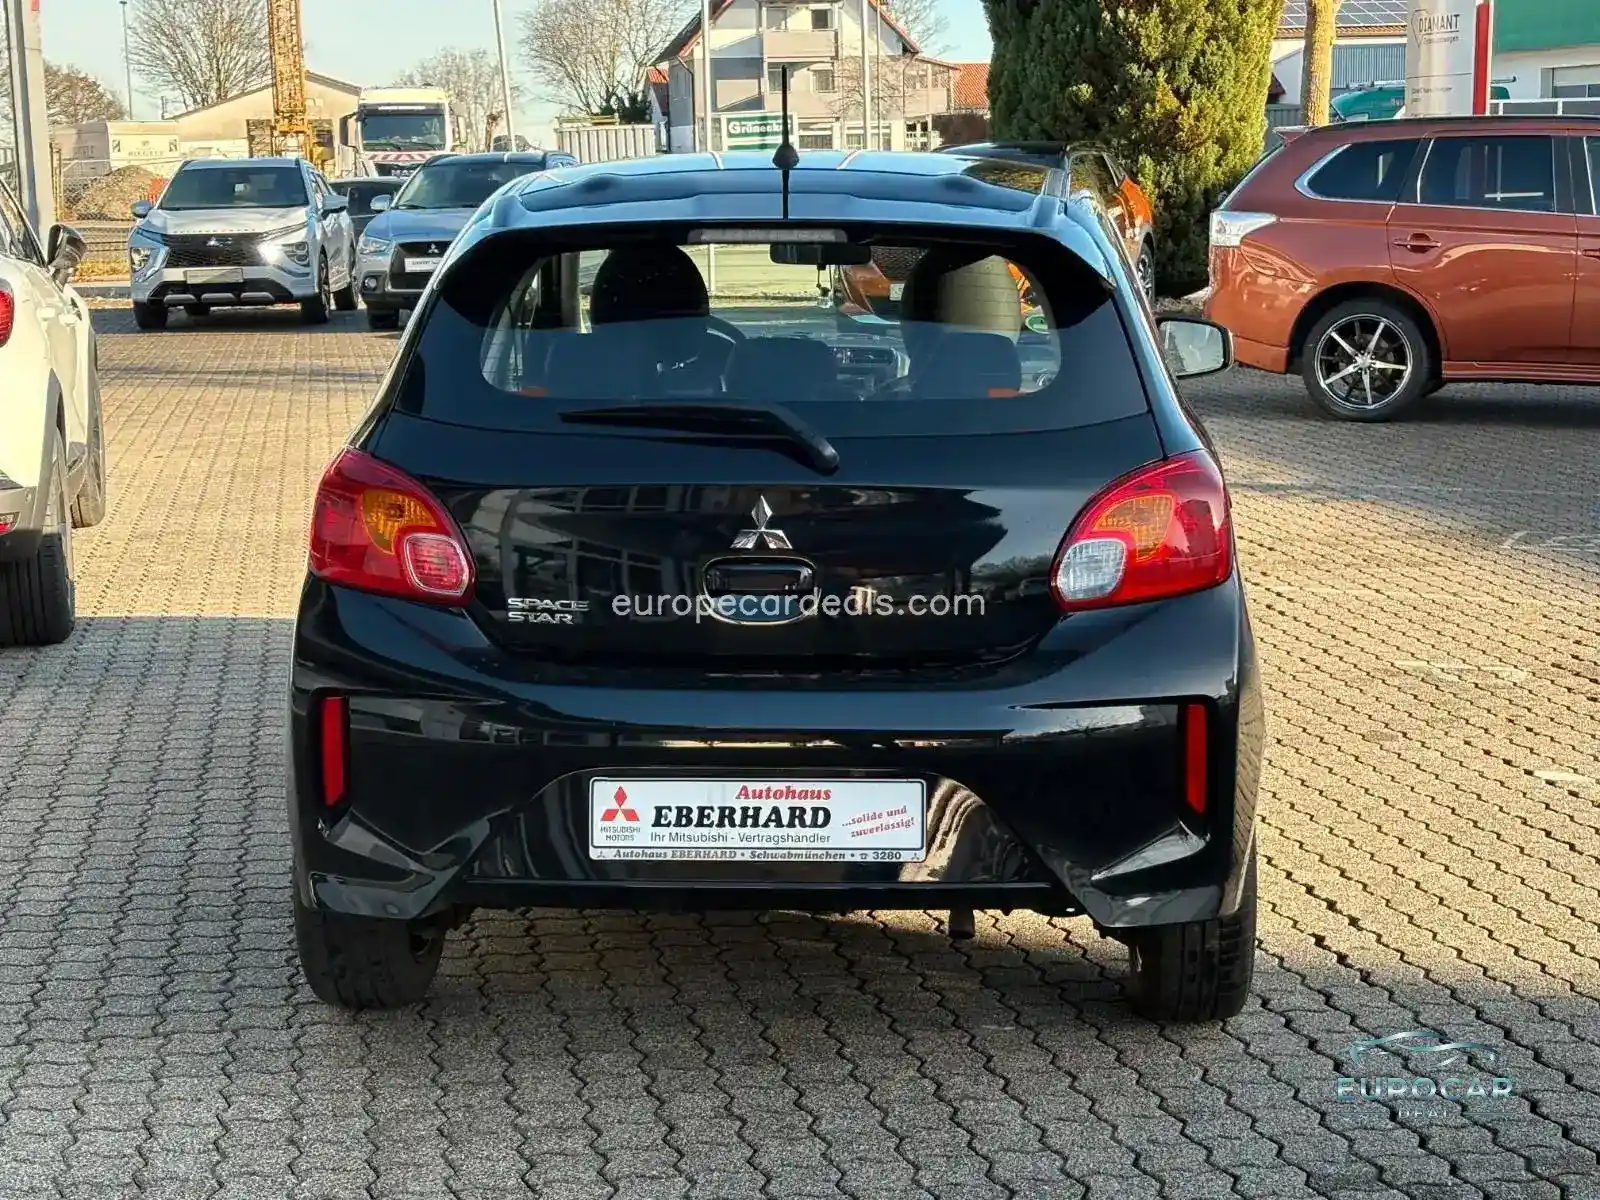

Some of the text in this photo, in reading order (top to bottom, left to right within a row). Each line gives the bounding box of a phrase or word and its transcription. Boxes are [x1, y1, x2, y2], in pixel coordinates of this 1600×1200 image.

[1418, 14, 1460, 33] DIAMANT
[507, 597, 590, 612] SPACE
[507, 611, 574, 625] STAR
[735, 784, 832, 801] Autohaus
[651, 805, 832, 829] EBERHARD
[886, 805, 908, 818] und
[600, 826, 641, 834] MITSUBISHI
[605, 834, 635, 842] MOTORS
[650, 832, 666, 843] Ihr
[672, 832, 728, 843] Mitsubishi
[613, 849, 902, 861] Autohaus EBERHARD Schwabmünchen 3280
